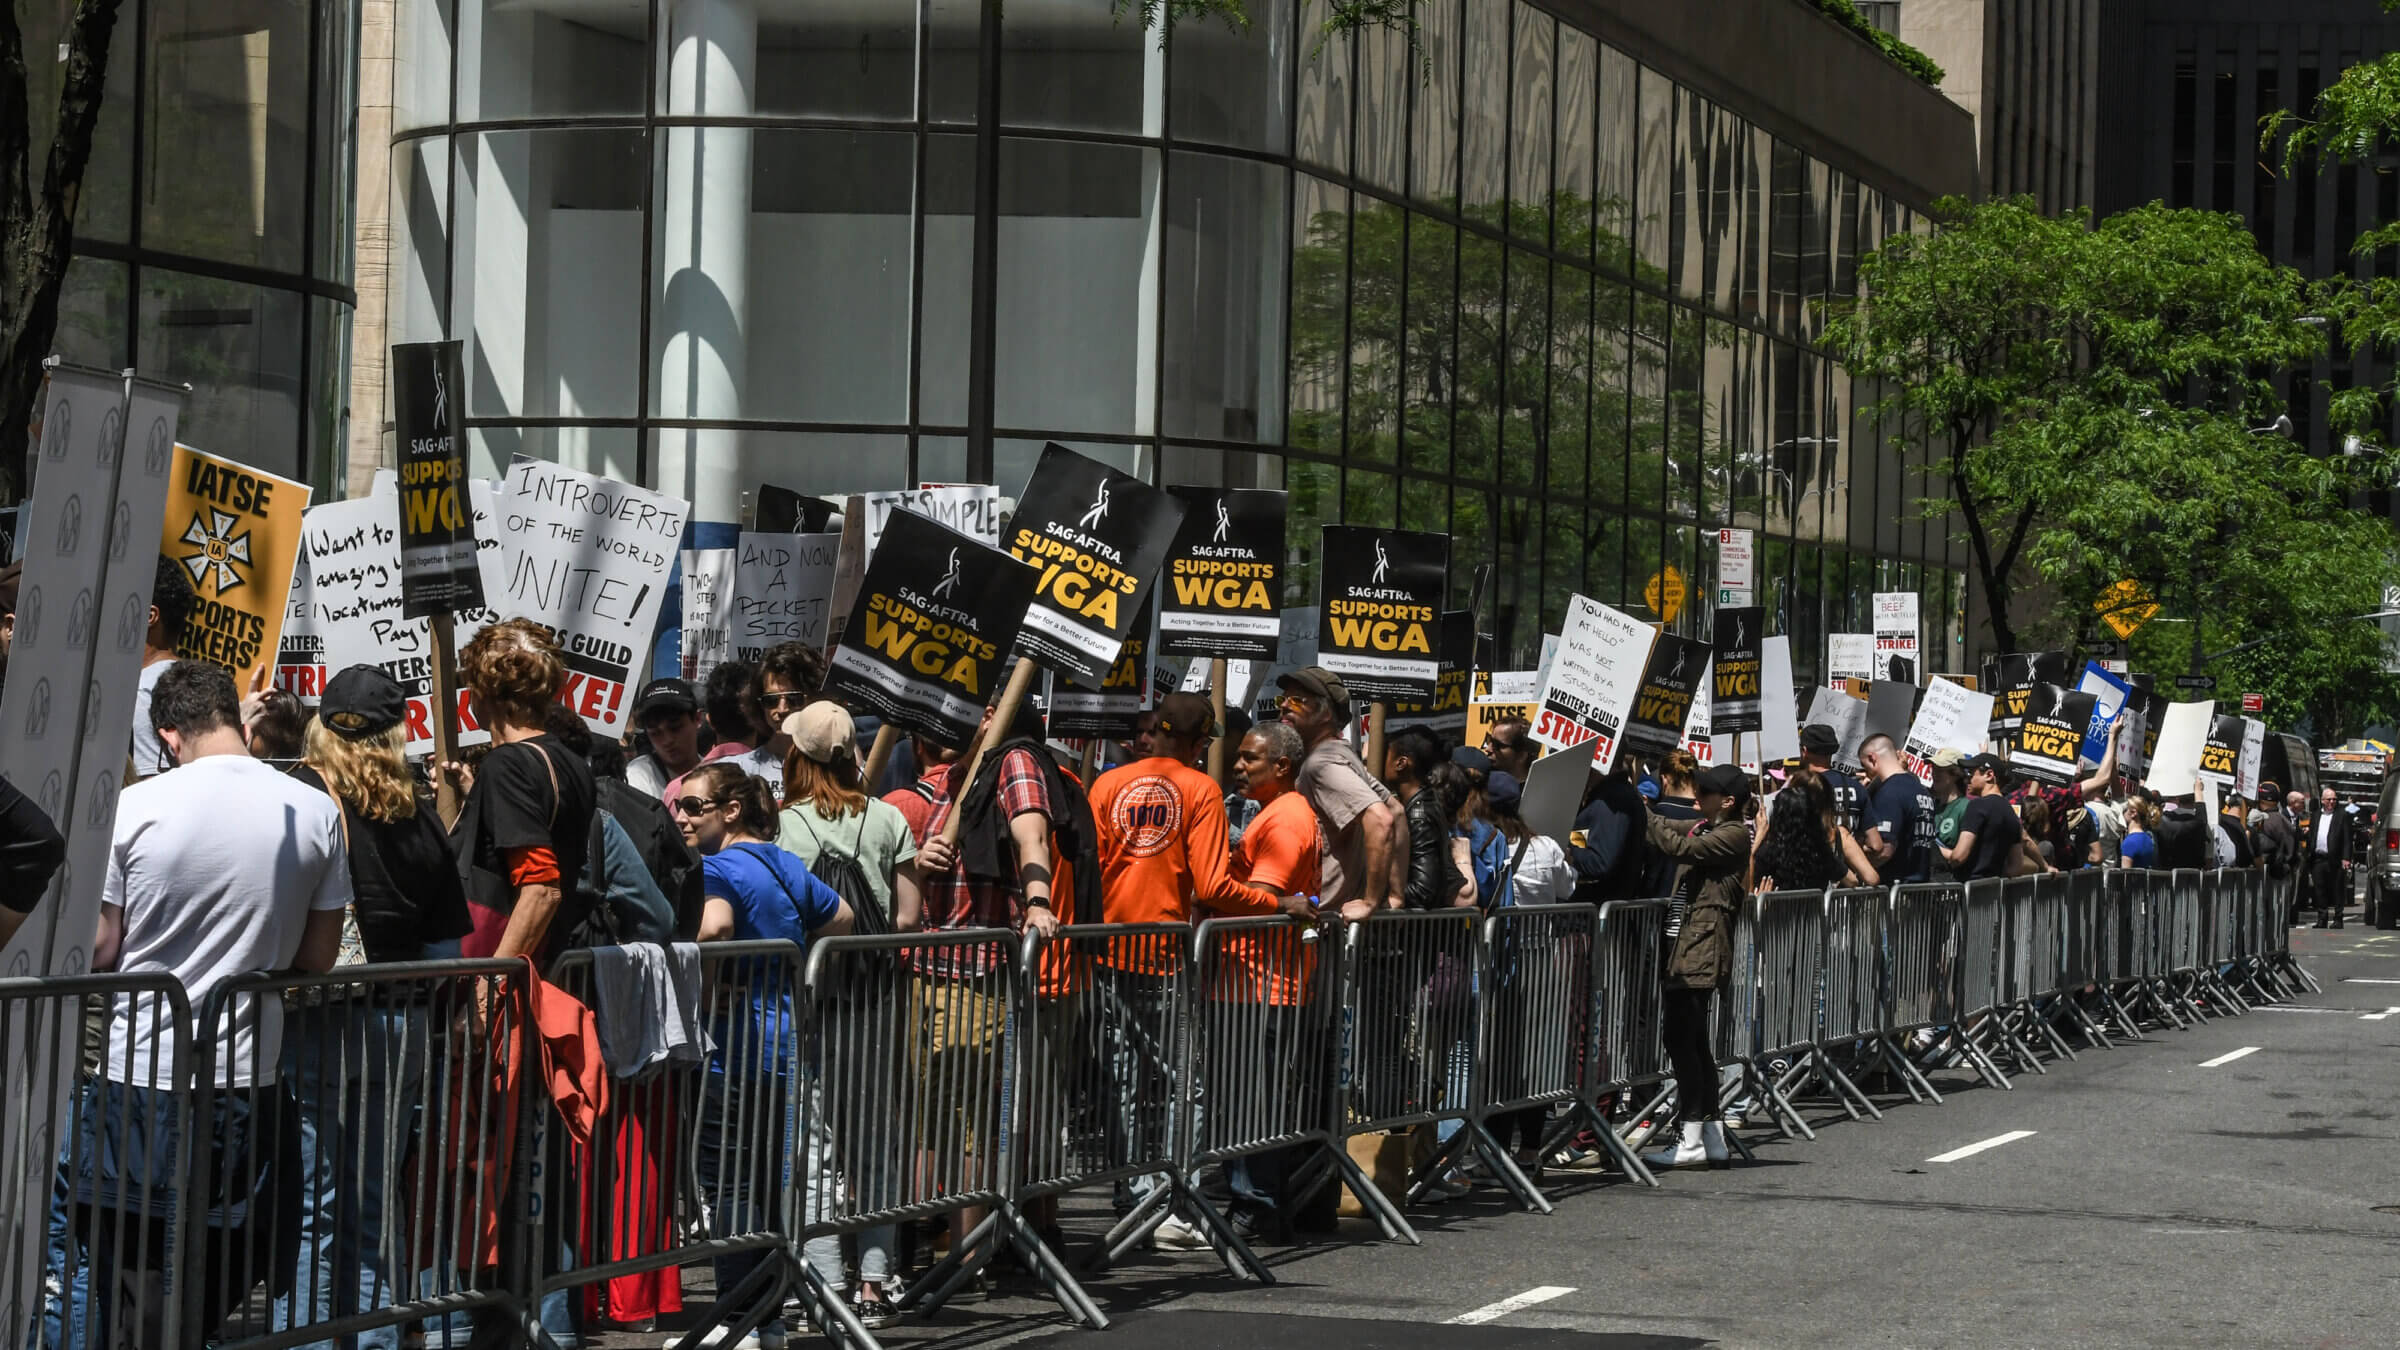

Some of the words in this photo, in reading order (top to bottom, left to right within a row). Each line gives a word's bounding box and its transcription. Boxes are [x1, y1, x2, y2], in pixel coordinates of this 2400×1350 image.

[187, 458, 273, 518] IATSE
[516, 466, 680, 538] INTROVERTS
[919, 490, 998, 535] SIMPLE
[310, 526, 364, 557] Want
[373, 523, 393, 546] to
[507, 514, 537, 533] OF
[548, 523, 584, 543] THE
[596, 535, 664, 572] WORLD
[1722, 530, 1729, 543] 3
[741, 543, 790, 567] AND
[800, 546, 836, 567] NOW
[1015, 528, 1138, 594] SUPPORTS
[316, 566, 389, 590] amazing
[767, 569, 787, 593] A
[1173, 559, 1274, 579] SUPPORTS
[696, 593, 717, 608] STEP
[737, 596, 824, 616] PICKET
[1173, 576, 1272, 610] WGA
[1722, 590, 1729, 603] 6
[1881, 602, 1905, 611] BEEF
[187, 595, 265, 644] PORTS
[1170, 618, 1191, 626] Acting
[1329, 600, 1433, 622] SUPPORTS
[1581, 599, 1602, 617] YOU
[1604, 614, 1620, 627] HAD
[1623, 622, 1636, 637] ME
[370, 619, 420, 651] Pay
[745, 619, 818, 638] SIGN
[869, 592, 997, 660] SUPPORTS
[1043, 615, 1054, 626] for
[1060, 623, 1083, 640] Better
[1084, 635, 1108, 652] Future
[1329, 617, 1430, 653] WGA
[1578, 620, 1589, 631] AT
[178, 619, 260, 669] RKERS'
[571, 633, 632, 666] GUILD
[701, 627, 729, 653] MUCH
[865, 610, 978, 695] WGA
[1569, 638, 1592, 657] WAS
[1595, 654, 1615, 668] NOT
[1876, 640, 1916, 650] STRIKE!
[1154, 666, 1177, 686] UILD
[1327, 660, 1347, 668] Acting
[1374, 662, 1382, 670] for
[1389, 664, 1408, 672] Better
[1563, 657, 1591, 677] WRITTEN
[1593, 671, 1606, 684] BY
[1606, 680, 1614, 688] A
[1716, 660, 1759, 673] SUPPORTS
[418, 680, 432, 694] O
[845, 655, 872, 671] Acting
[873, 667, 903, 689] Together
[922, 690, 944, 704] Better
[946, 701, 971, 716] Future
[1562, 674, 1595, 697] STUDIO
[1598, 693, 1618, 706] SUIT
[1643, 685, 1689, 705] SUPPORTS
[1716, 674, 1757, 697] WGA
[1549, 687, 1590, 715] WRITERS
[1591, 706, 1619, 729] GUILD
[1576, 714, 1586, 726] ON
[1637, 697, 1680, 726] WGA
[2025, 722, 2080, 743] SUPPORTS
[2023, 732, 2074, 761] WGA
[2204, 745, 2235, 758] PORTS
[1341, 1008, 1352, 1085] NYPD
